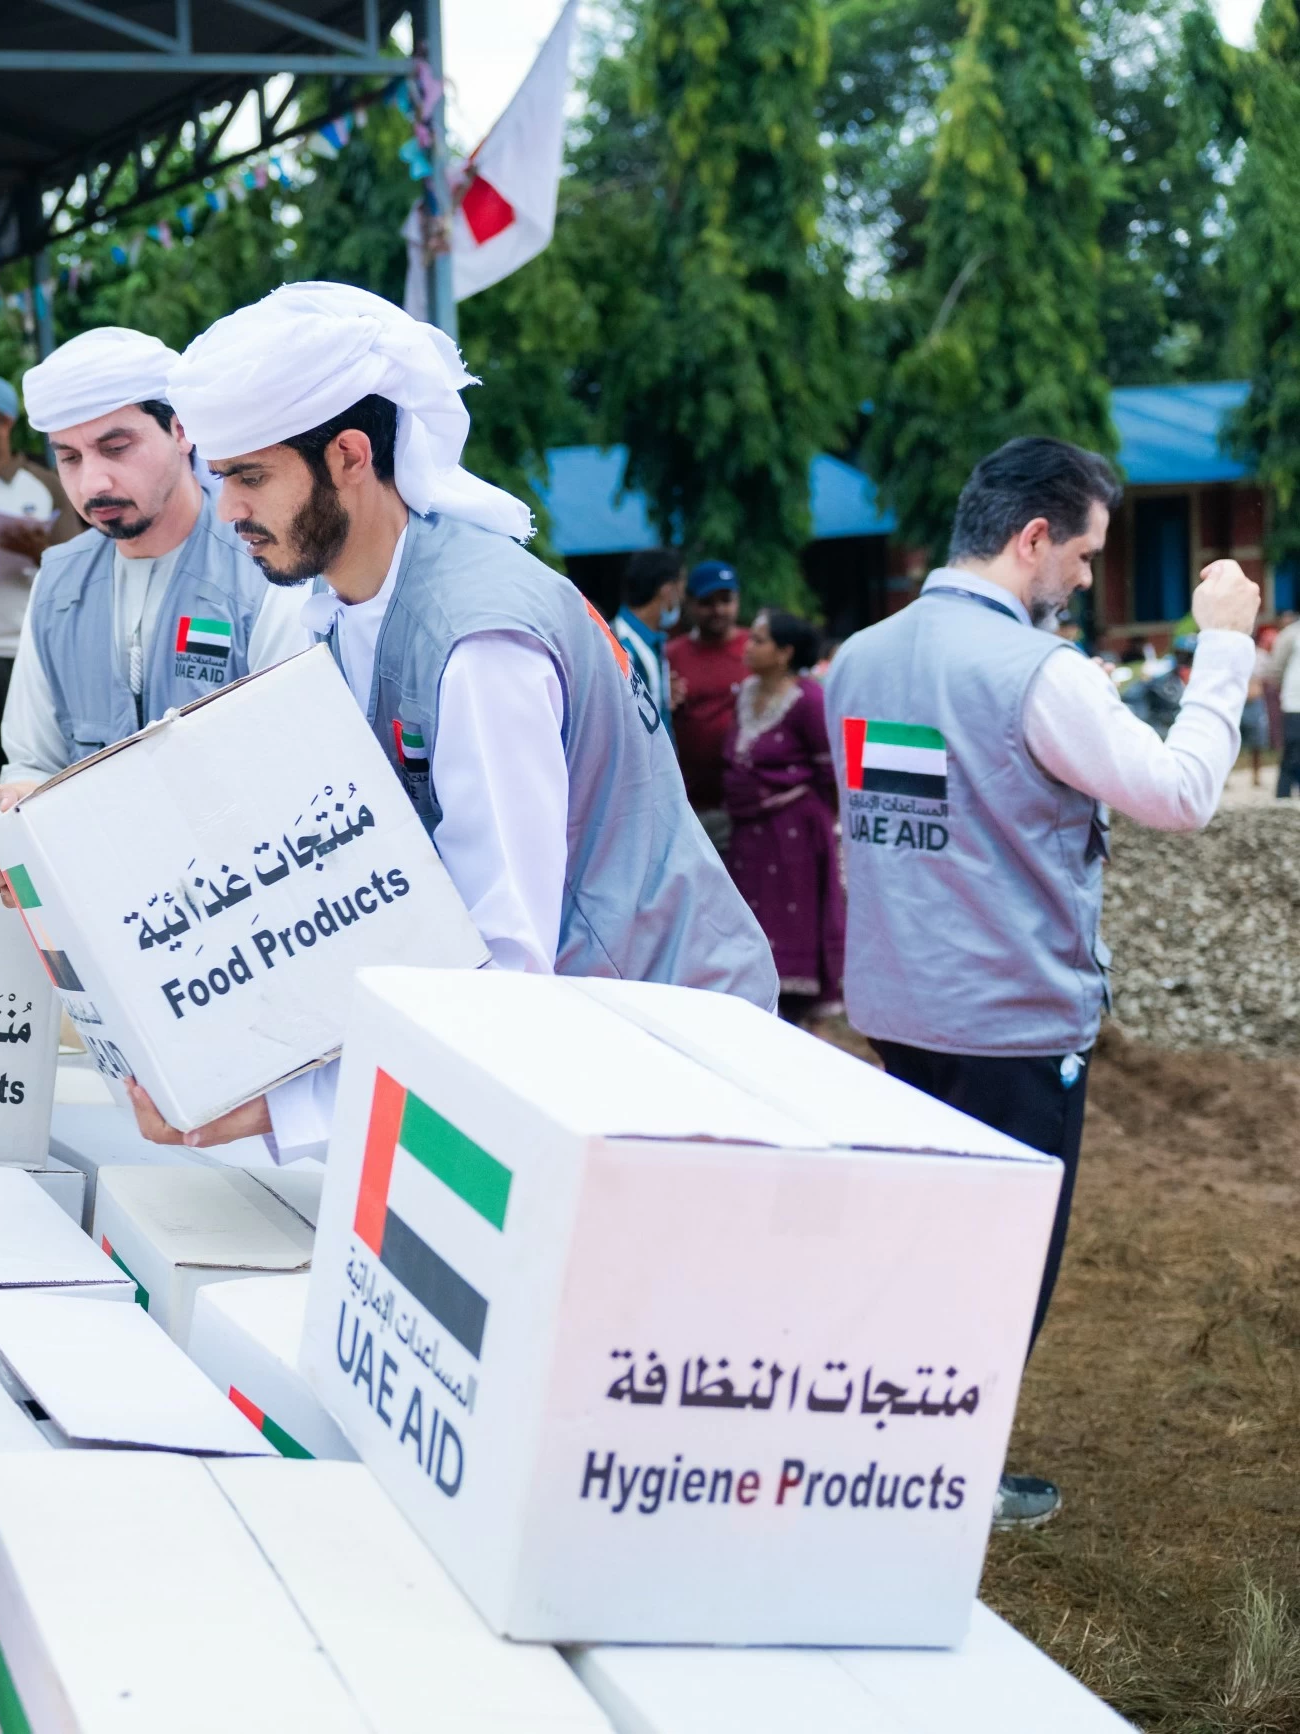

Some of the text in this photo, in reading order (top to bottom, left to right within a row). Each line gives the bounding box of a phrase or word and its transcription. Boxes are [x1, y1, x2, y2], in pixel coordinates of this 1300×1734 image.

[175, 663, 225, 683] UAE AID
[848, 812, 949, 852] UAE AID
[160, 867, 411, 1020] Food Products
[336, 1299, 464, 1498] UAE AID
[606, 1348, 981, 1432] منتجات النظافة
[581, 1448, 967, 1514] Hygiene Products
